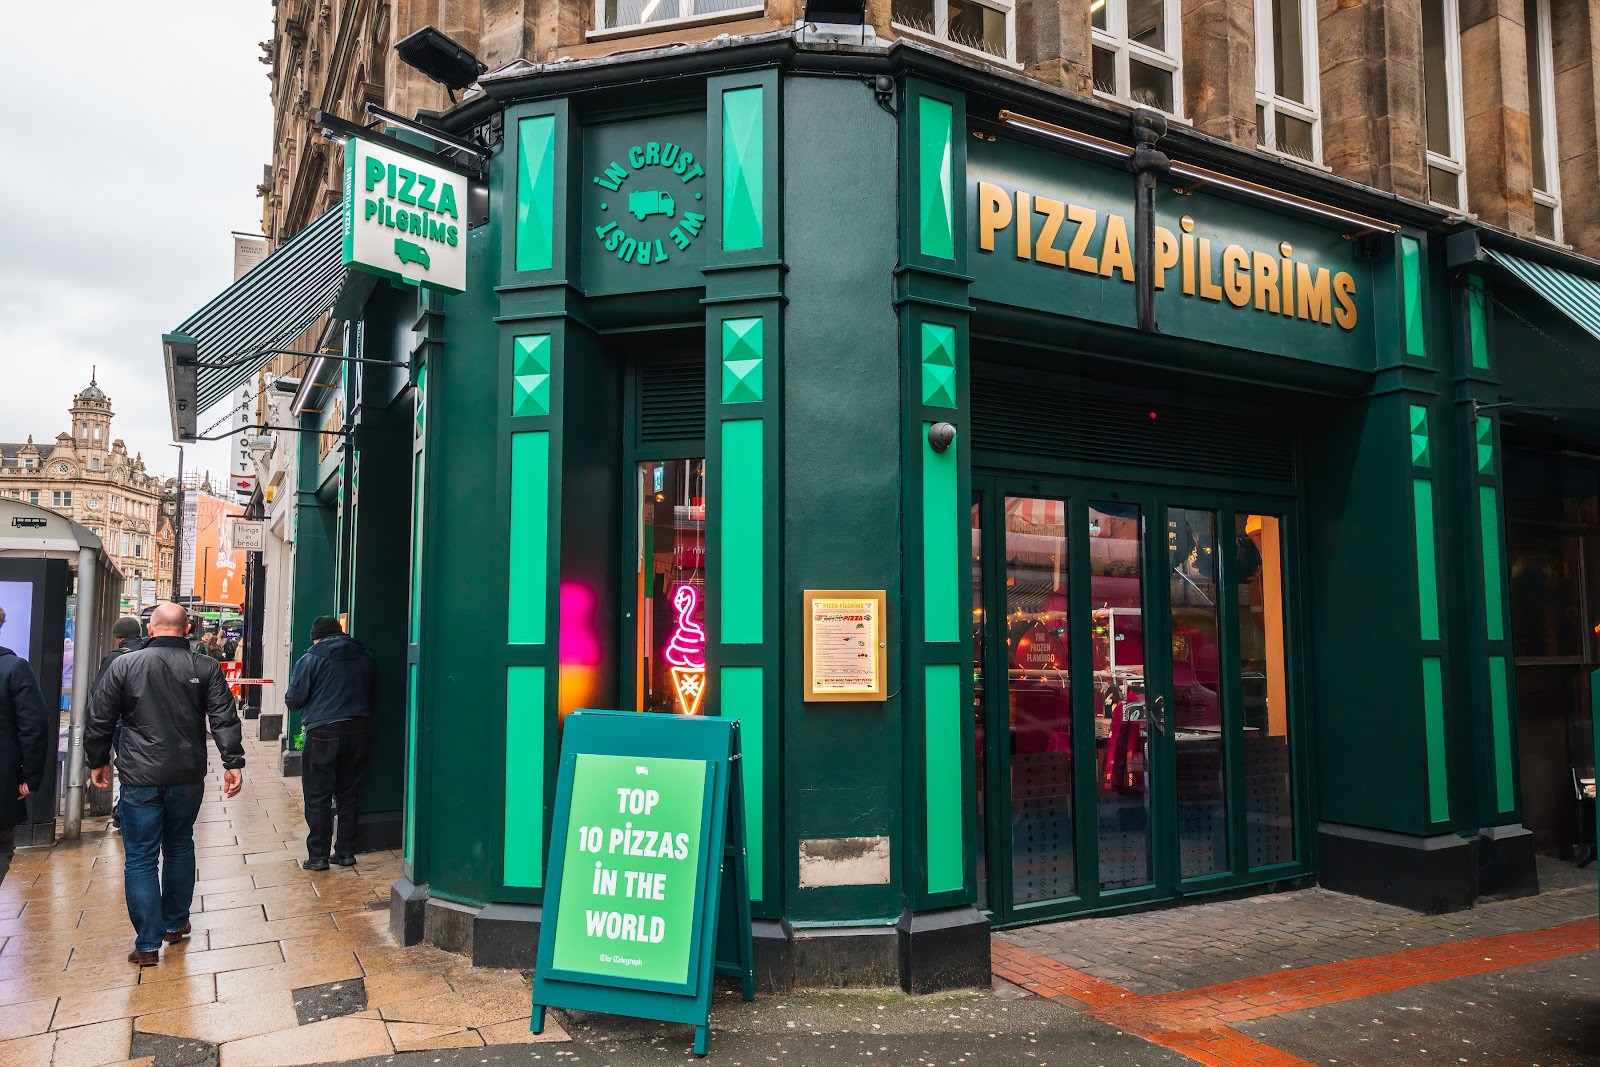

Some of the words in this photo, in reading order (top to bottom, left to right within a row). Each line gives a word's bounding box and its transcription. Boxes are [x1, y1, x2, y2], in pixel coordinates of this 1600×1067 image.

[629, 142, 706, 184] CRUST
[366, 156, 459, 220] PIZZA
[595, 220, 669, 265] TRUST
[669, 211, 706, 251] WE
[977, 181, 1136, 283] PIZZA
[238, 539, 258, 547] bread
[239, 526, 258, 535] things
[1030, 643, 1051, 652] FROZEN
[1035, 633, 1045, 641] THE
[1026, 653, 1055, 662] FLAMINGO
[617, 787, 659, 815] TOP
[579, 826, 603, 853] 10
[624, 870, 667, 901] THE
[586, 909, 665, 943] WORLD
[600, 953, 612, 962] The
[613, 955, 643, 967] Telegraph
